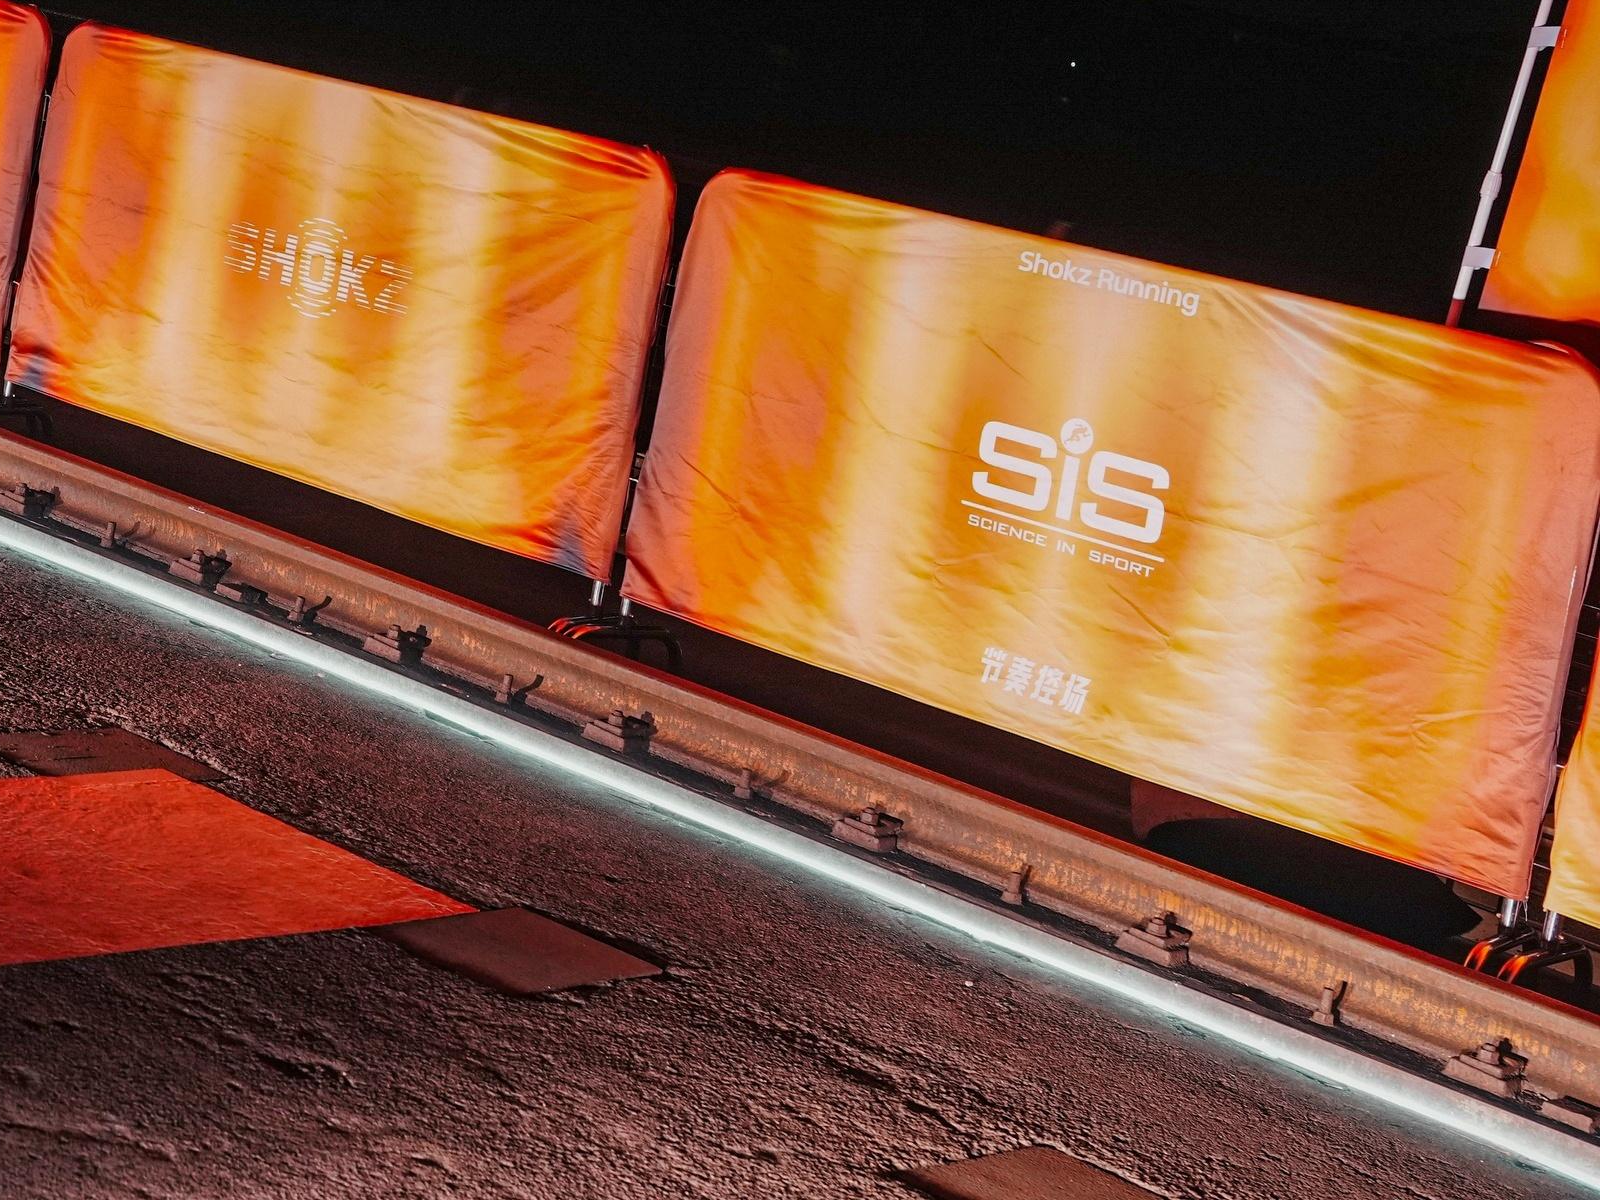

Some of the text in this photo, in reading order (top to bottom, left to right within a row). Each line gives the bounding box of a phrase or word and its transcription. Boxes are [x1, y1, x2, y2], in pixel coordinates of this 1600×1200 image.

[223, 219, 415, 318] SHOKZ
[1017, 250, 1201, 318] Shokz Running
[972, 417, 1170, 544] SiS
[967, 513, 1155, 578] SCIENCE IN SPORT
